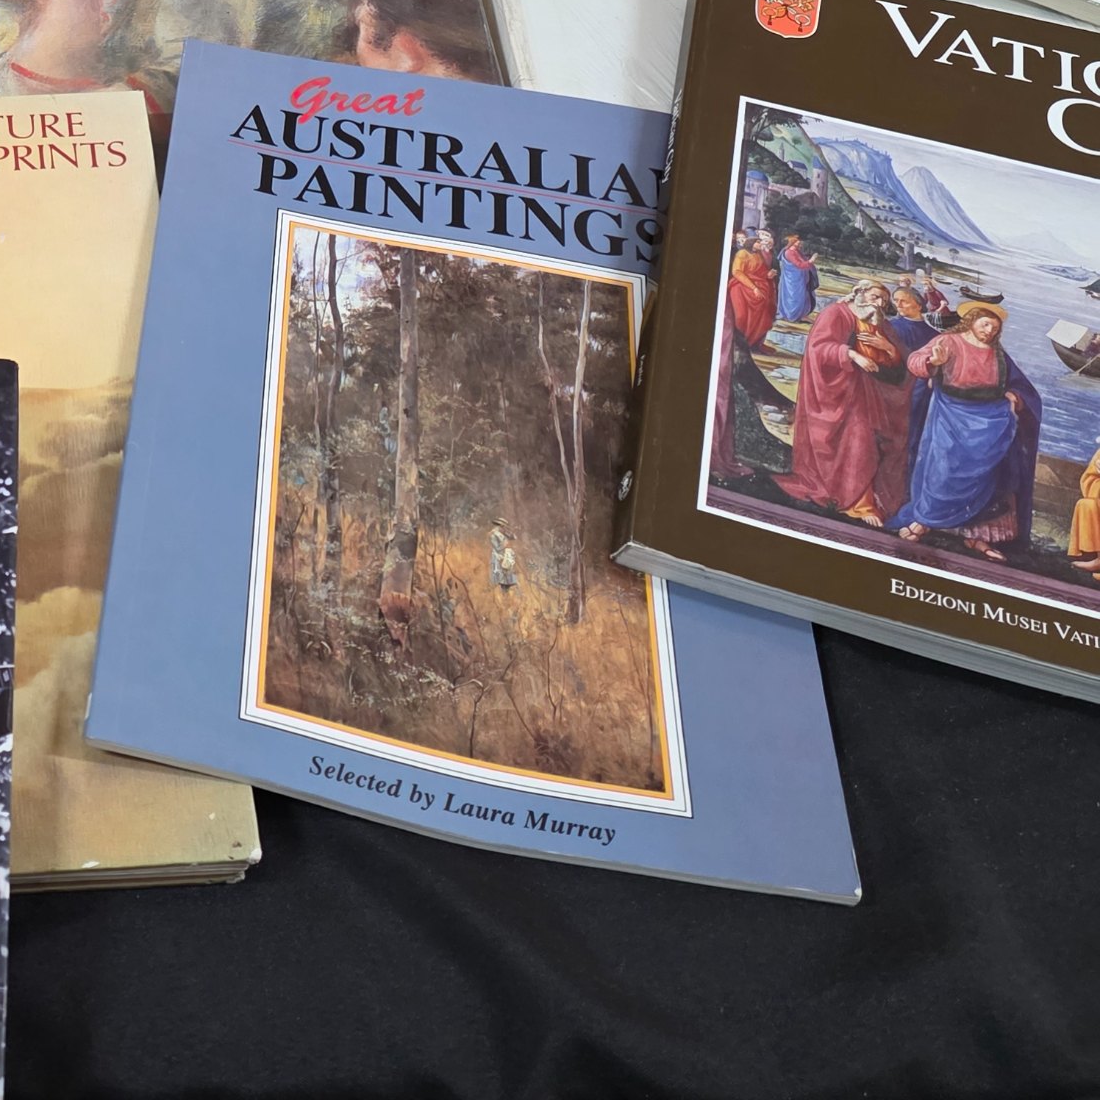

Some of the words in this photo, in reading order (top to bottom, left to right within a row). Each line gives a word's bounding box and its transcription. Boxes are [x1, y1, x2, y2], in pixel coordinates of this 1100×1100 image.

[290, 76, 426, 124] Great
[254, 152, 664, 265] PAINTINGS
[889, 578, 976, 616] EDIZIONI
[983, 603, 1048, 635] MUSEI
[308, 755, 403, 798] Selected
[410, 783, 436, 811] by
[443, 792, 516, 826] Laura
[523, 810, 617, 846] Murray
